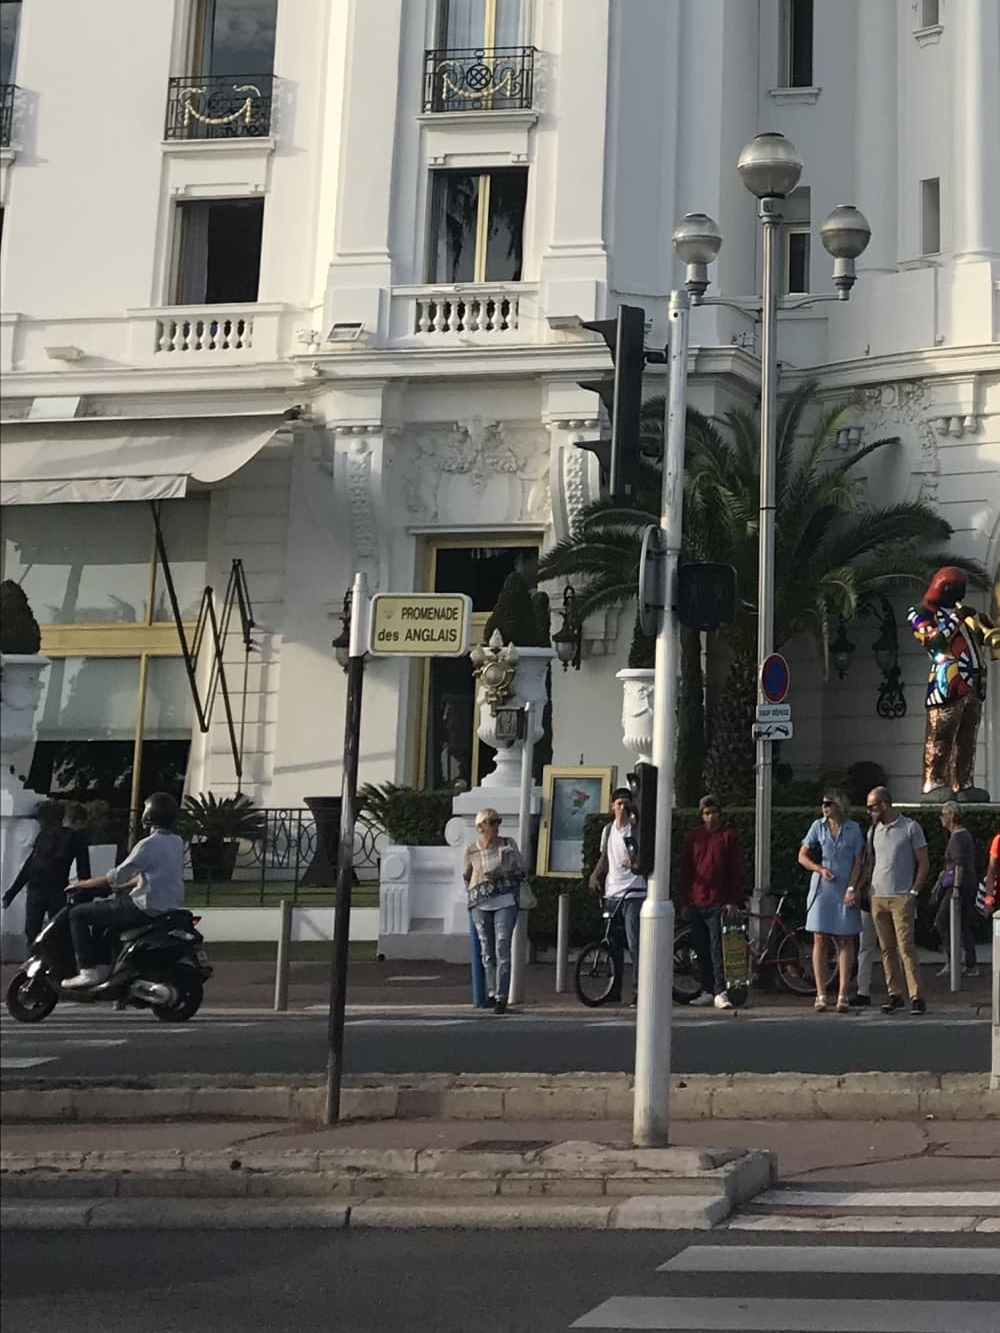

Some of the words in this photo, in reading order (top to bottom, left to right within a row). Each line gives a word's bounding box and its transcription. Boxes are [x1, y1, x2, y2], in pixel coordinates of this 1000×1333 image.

[400, 607, 459, 620] PROMENADE
[378, 628, 400, 642] des
[404, 628, 457, 642] ANGLAIS
